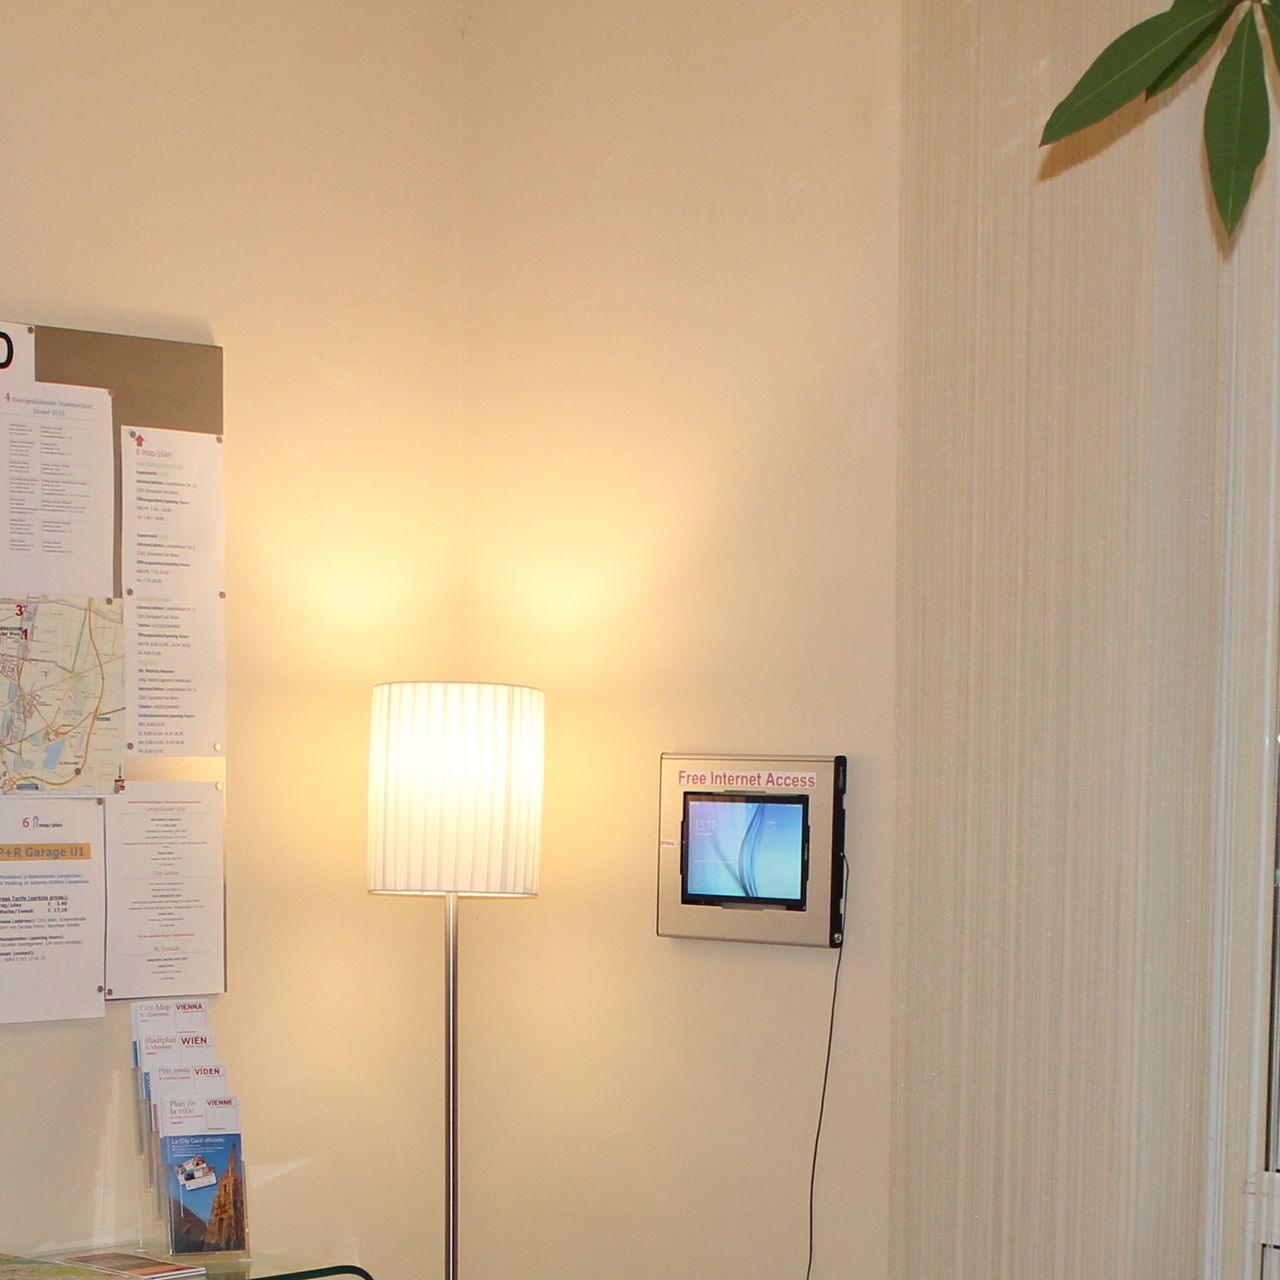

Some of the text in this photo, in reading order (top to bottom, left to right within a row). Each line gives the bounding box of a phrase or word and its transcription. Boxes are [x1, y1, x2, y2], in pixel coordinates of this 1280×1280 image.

[5, 392, 10, 402] 4
[16, 604, 24, 616] 3
[678, 770, 816, 788] Free Internet Access
[22, 817, 30, 828] 6
[26, 846, 67, 860] Garage
[70, 846, 84, 857] U1
[181, 1036, 208, 1046] WIEN
